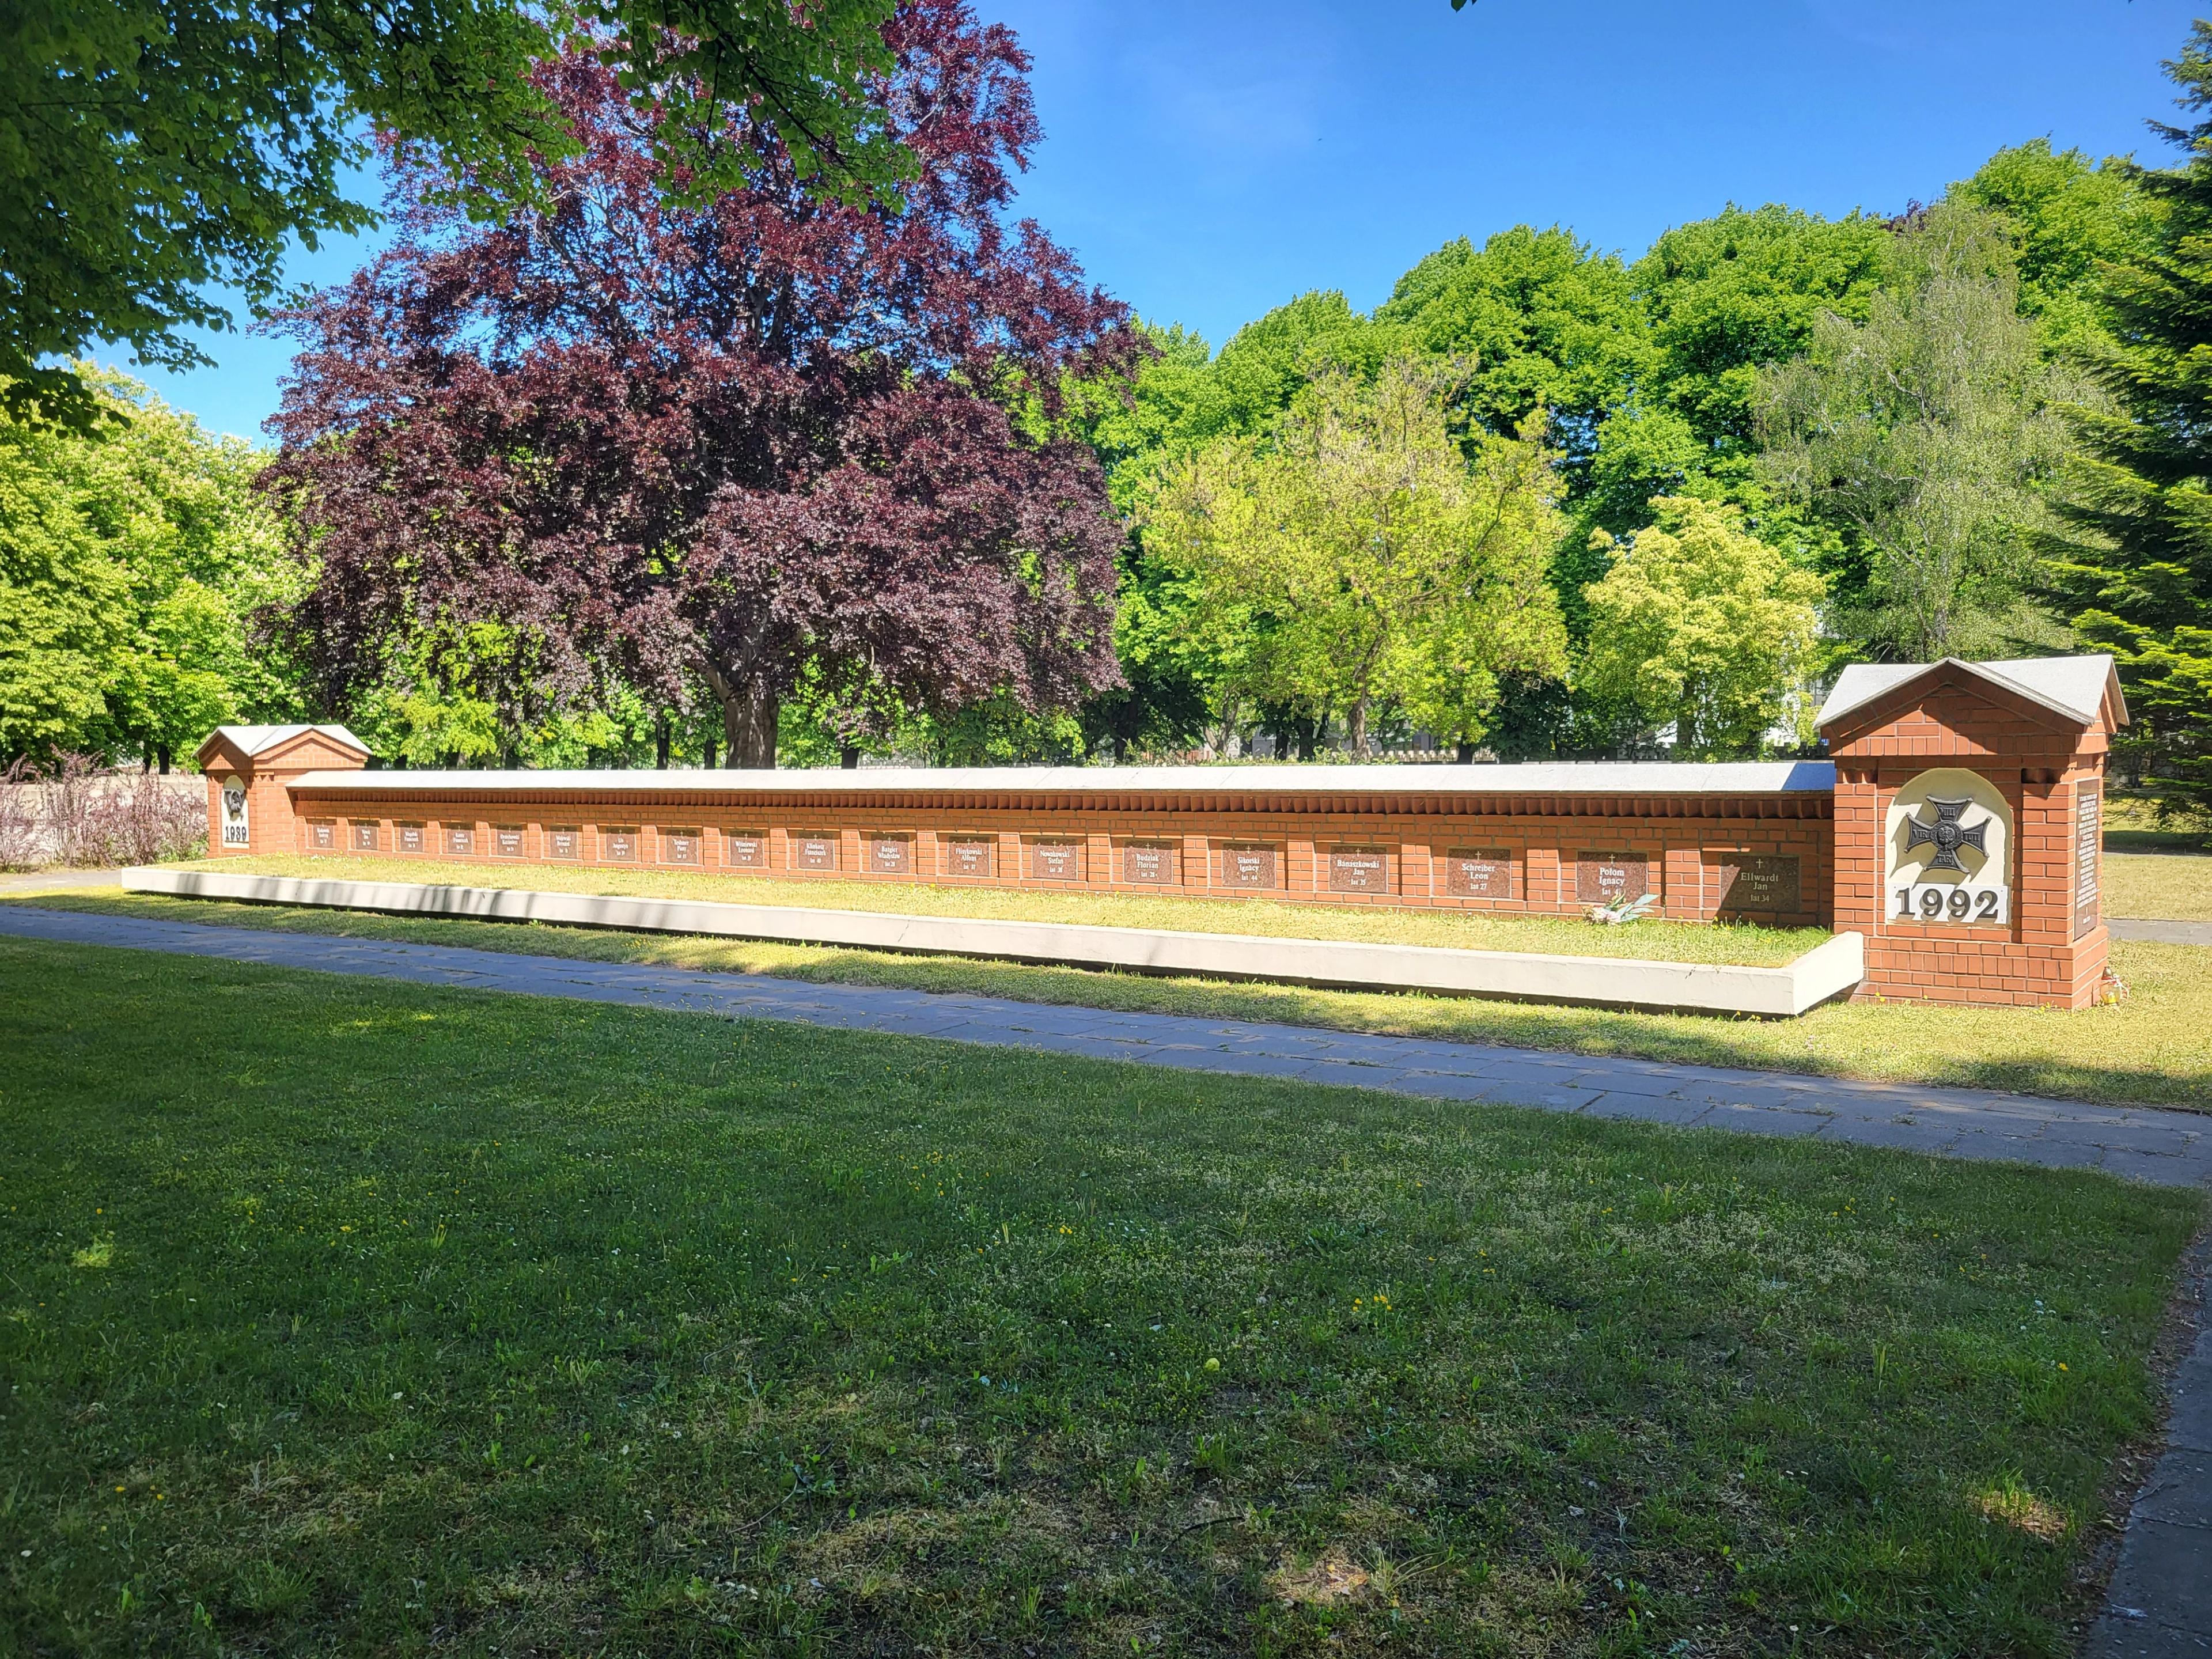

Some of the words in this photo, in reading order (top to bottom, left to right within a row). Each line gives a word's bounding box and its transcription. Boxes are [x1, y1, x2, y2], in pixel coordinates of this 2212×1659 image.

[1040, 850, 1070, 858] Nowakowski
[1136, 853, 1159, 861] Budziak
[1337, 859, 1380, 868] Banaszkowski
[1461, 863, 1495, 872] Schreiber
[1239, 864, 1259, 873] Ignacy
[1353, 868, 1365, 876] Jan
[1470, 872, 1488, 880] Leon
[1741, 872, 1779, 882] Ellwardt
[1599, 876, 1625, 886] Ignacy
[1753, 882, 1768, 890] Jan
[1898, 888, 1998, 919] 1992
